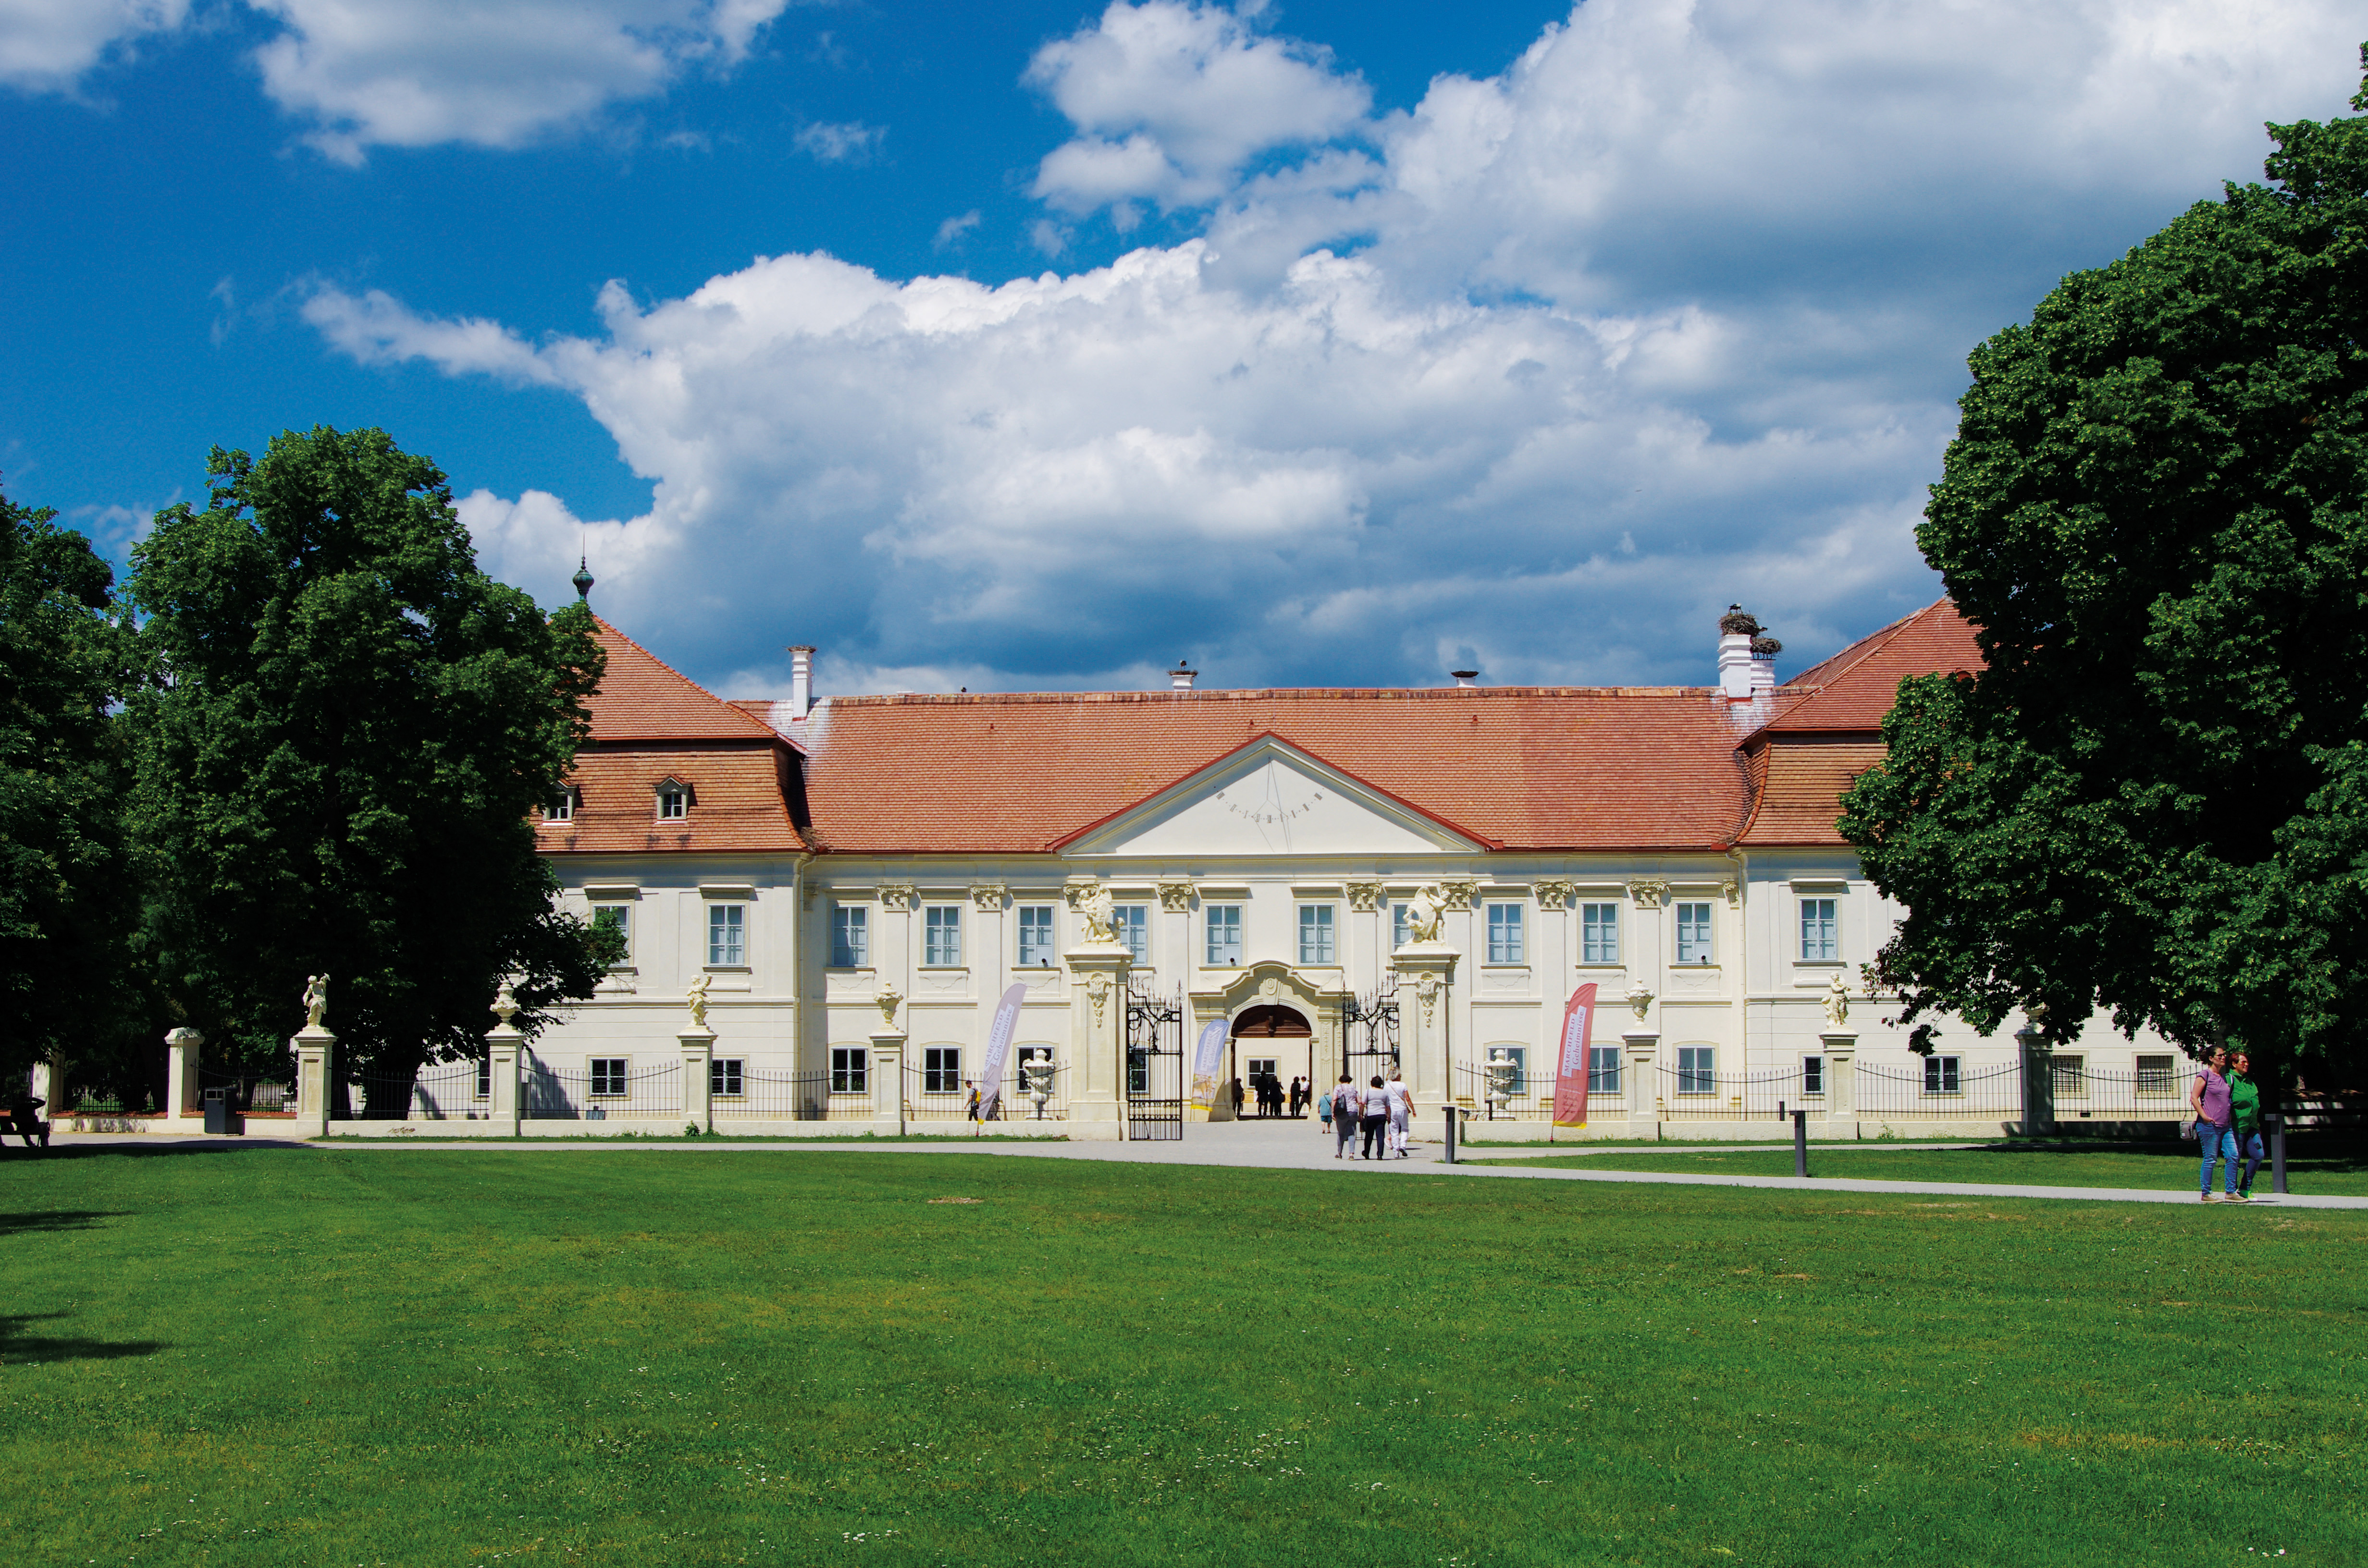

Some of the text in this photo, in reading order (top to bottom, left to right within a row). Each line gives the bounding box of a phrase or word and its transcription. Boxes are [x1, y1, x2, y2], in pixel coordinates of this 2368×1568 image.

[993, 1009, 1012, 1060] Geheimnisse
[1565, 1018, 1575, 1072] MARCHFELD
[1572, 1011, 1584, 1065] Geheimnisse
